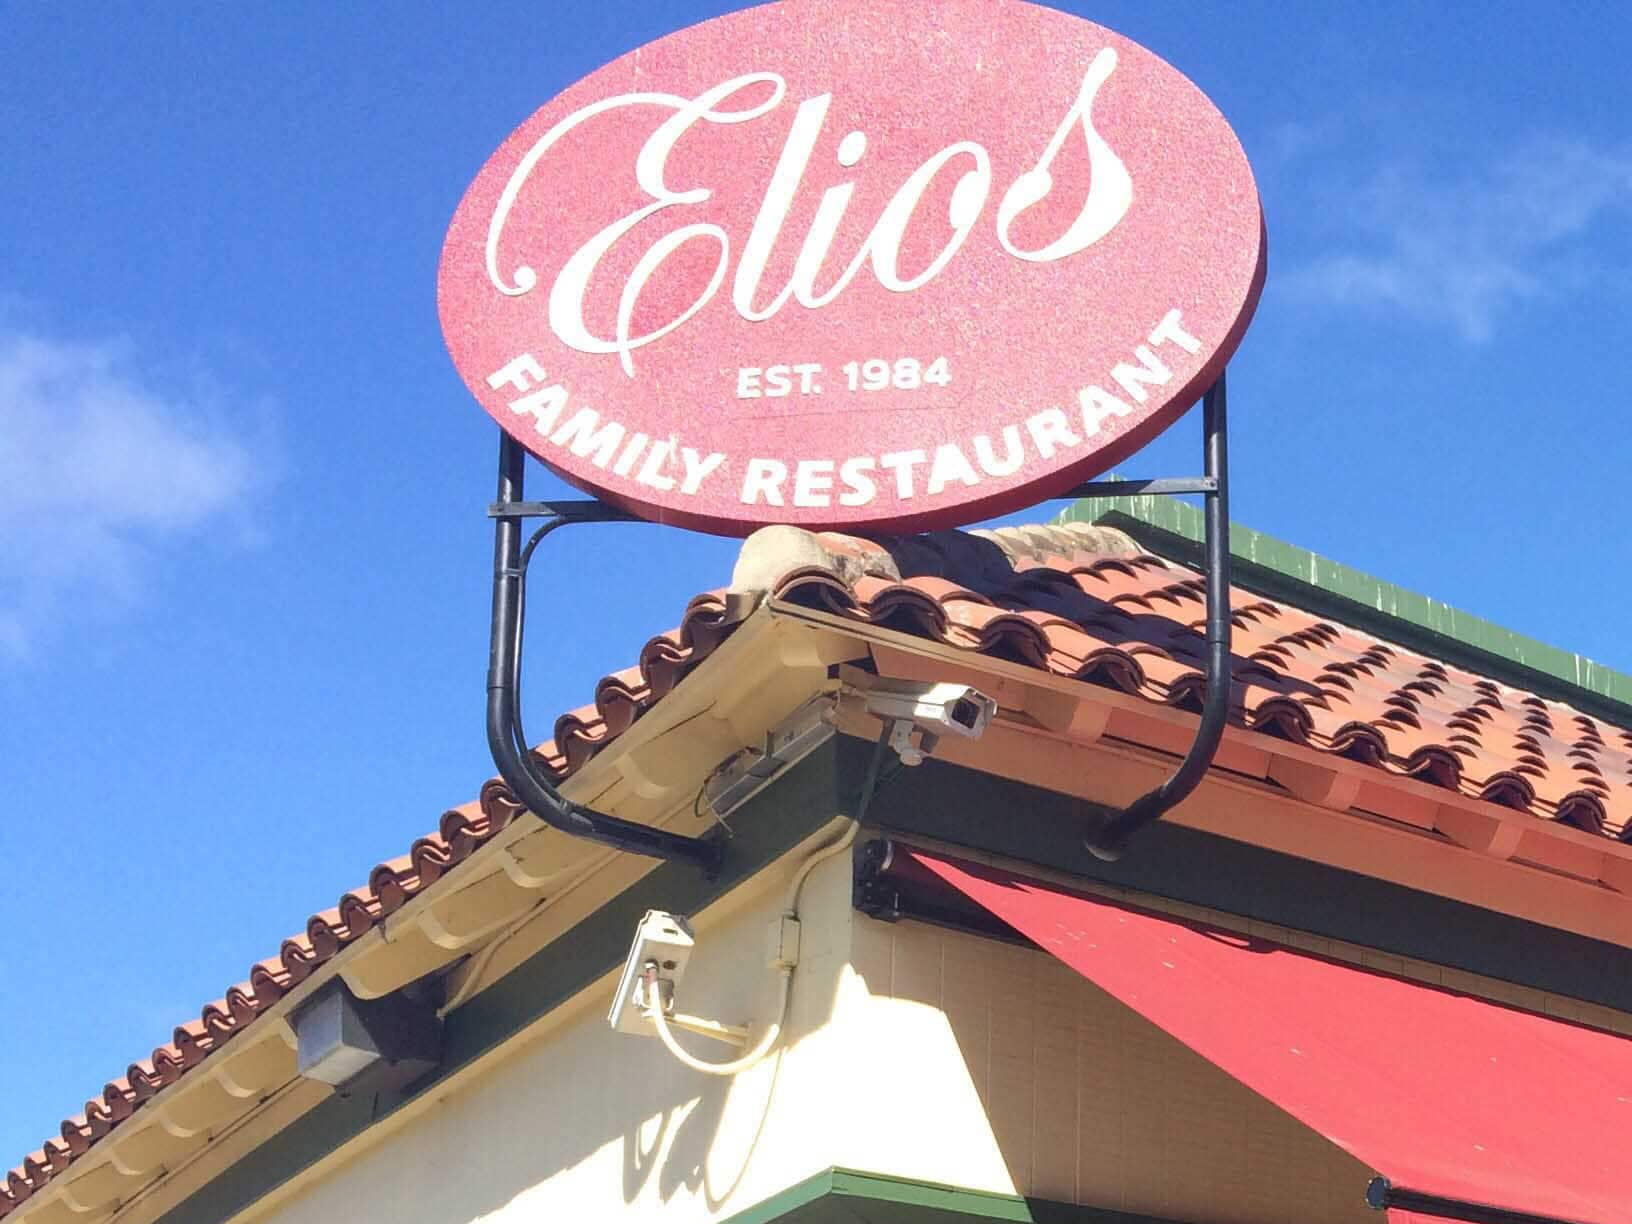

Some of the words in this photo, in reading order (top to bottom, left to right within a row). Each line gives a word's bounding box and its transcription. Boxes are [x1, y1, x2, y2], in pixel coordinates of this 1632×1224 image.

[486, 352, 727, 496] FAMILY
[740, 307, 1202, 507] RESTAURANT
[736, 364, 823, 400] EST.
[842, 356, 952, 392] 1984
